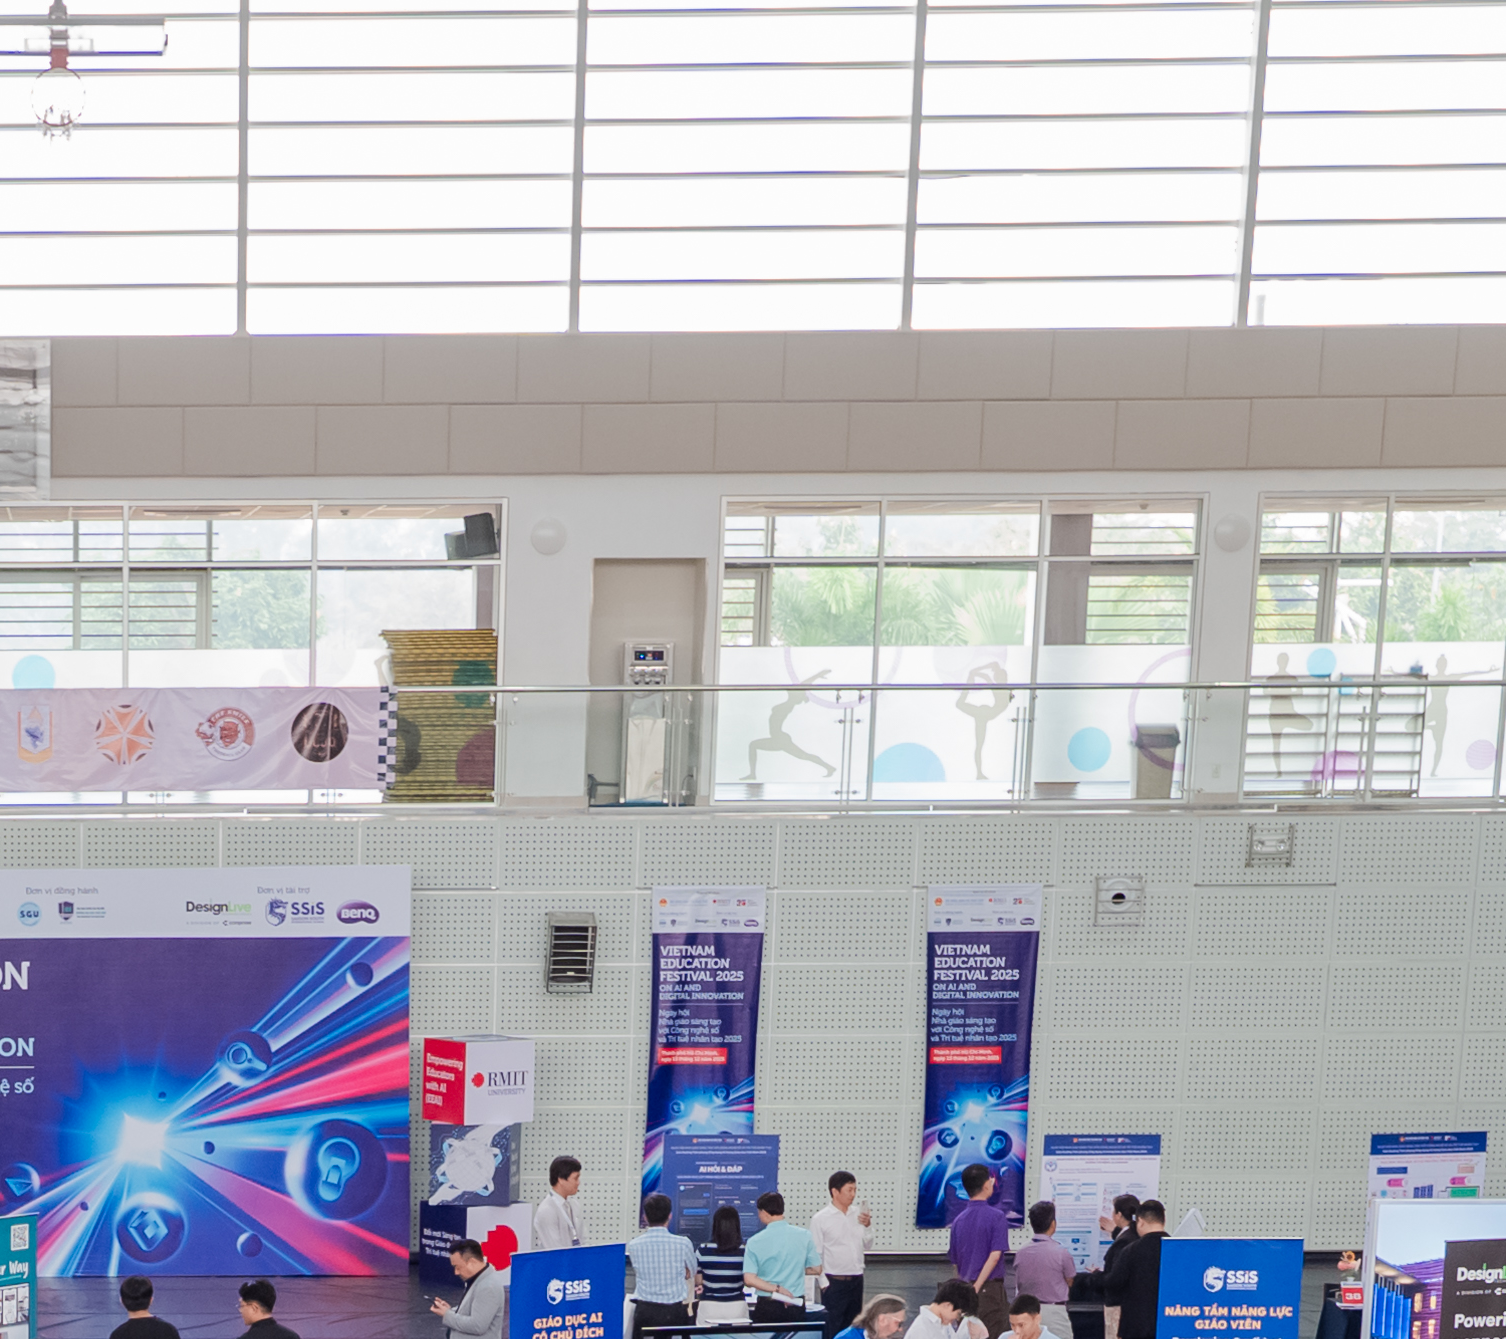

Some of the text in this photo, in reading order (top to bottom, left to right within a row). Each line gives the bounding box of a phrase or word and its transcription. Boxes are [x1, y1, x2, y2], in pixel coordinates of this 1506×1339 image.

[291, 901, 325, 916] SSiS
[660, 946, 716, 956] VIETNAM
[934, 944, 990, 956] VIETNAM
[660, 958, 730, 969] EDUCATION
[934, 957, 1006, 968] EDUCATION
[660, 971, 744, 982] FESTIVAL 2025
[934, 970, 1020, 980] FESTIVAL 2025
[488, 1070, 529, 1086] RMIT
[14, 1076, 34, 1094] số
[488, 1088, 526, 1096] UNIVERSITY
[8, 1260, 29, 1279] Way
[1226, 1270, 1258, 1284] SSiS
[565, 1279, 591, 1294] SSiS
[1270, 1306, 1293, 1319] LỰC
[534, 1312, 603, 1329] GIÁO DỤC AI
[1194, 1318, 1261, 1330] GIÁO VIÊN
